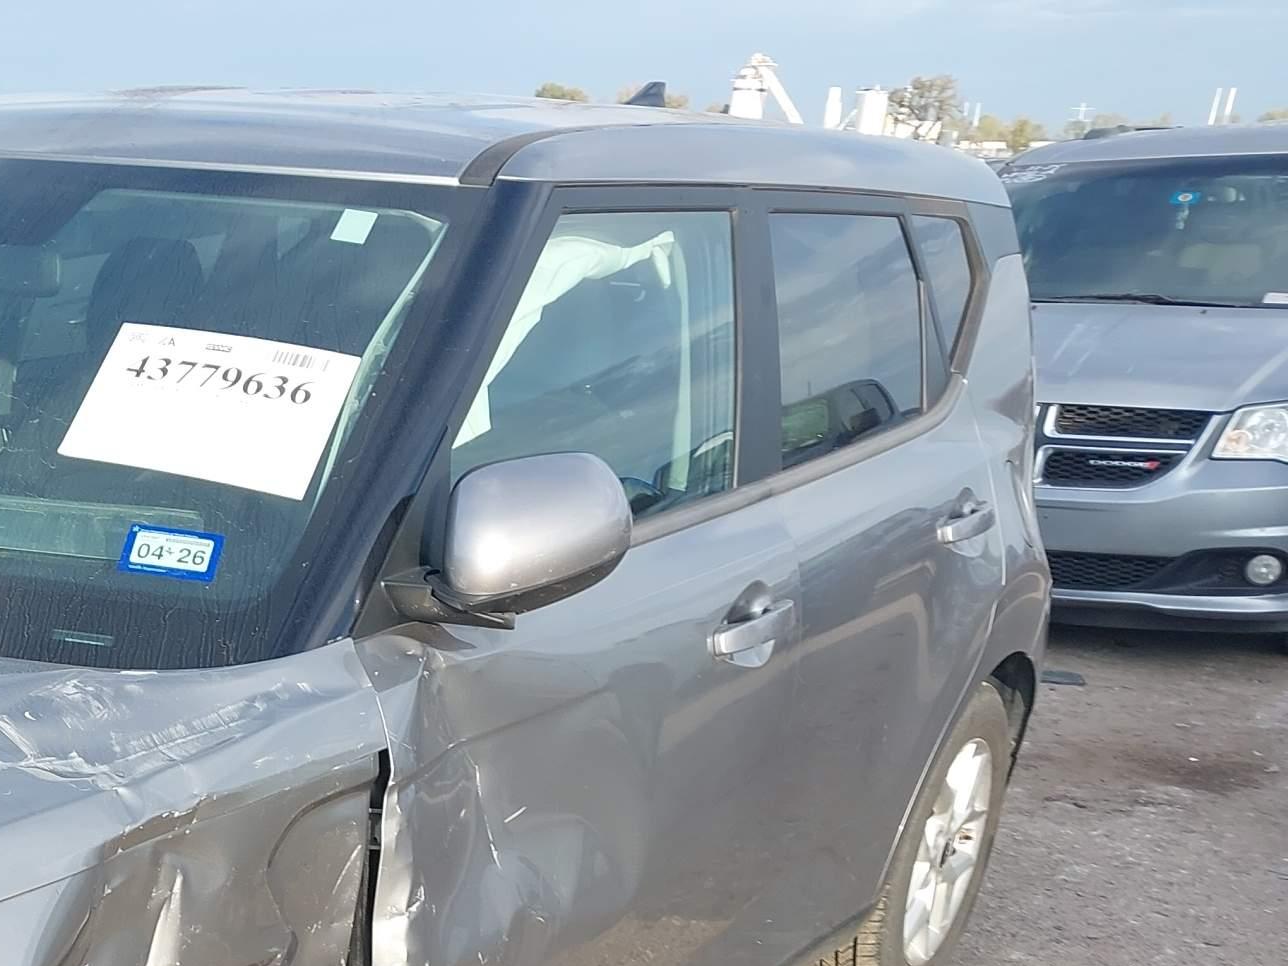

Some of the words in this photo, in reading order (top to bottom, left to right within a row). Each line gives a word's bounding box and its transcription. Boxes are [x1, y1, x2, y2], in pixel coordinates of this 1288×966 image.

[125, 354, 316, 405] 43779636
[137, 543, 164, 561] 04
[176, 547, 207, 566] 26
